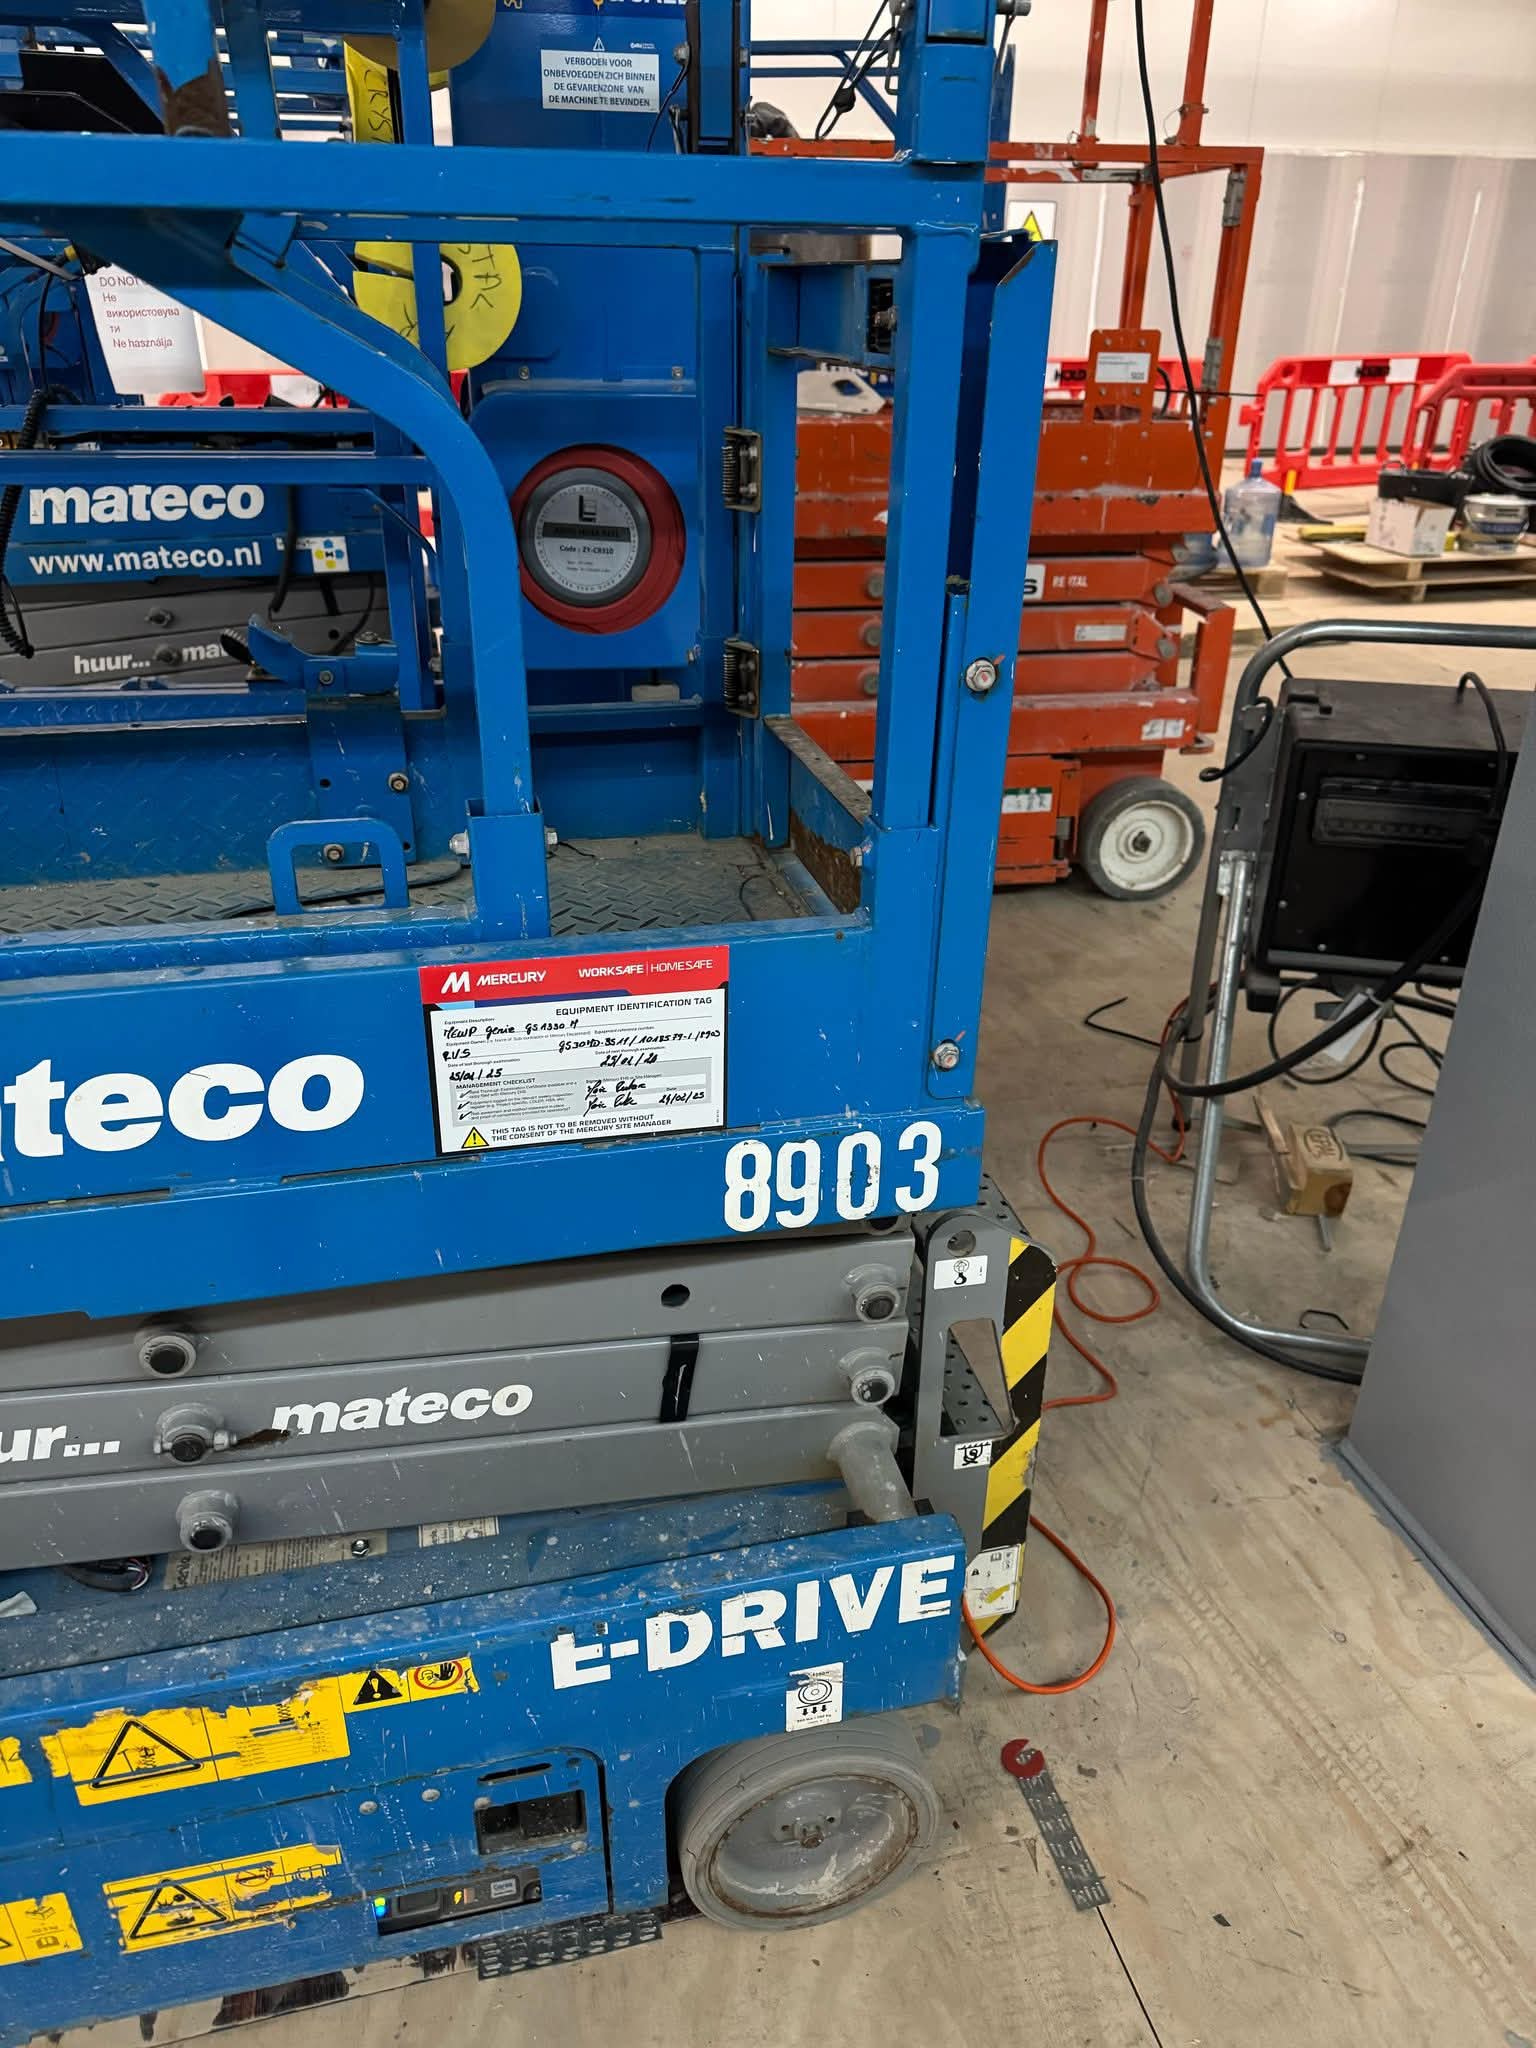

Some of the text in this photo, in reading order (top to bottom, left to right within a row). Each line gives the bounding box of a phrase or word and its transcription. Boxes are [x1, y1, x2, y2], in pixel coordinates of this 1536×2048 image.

[565, 57, 632, 67] VERBODEN VOOR
[543, 69, 656, 81] ONBEVOEGDEN ZICH BINNEN
[554, 82, 644, 94] DE GEVARENZONE VAN
[549, 95, 650, 106] DE MACHINE TE BEVINDEN
[99, 277, 116, 287] DO
[113, 339, 127, 348] Ne
[29, 484, 264, 524] mateco
[29, 542, 262, 575] www.mateco.nl
[73, 653, 151, 674] huur...
[476, 970, 547, 987] MERCURY
[578, 964, 644, 978] WORKSAFE
[650, 959, 713, 973] HOMESAFE
[555, 997, 712, 1016] EQUIPMENT IDENTIFICATION TAG
[456, 1081, 501, 1089] MANAGEMENT
[503, 1078, 535, 1086] CHECKLIST
[0, 1054, 365, 1163] teco
[579, 1117, 617, 1126] REMOVED
[618, 1114, 654, 1122] WITHOUT
[492, 1134, 507, 1142] THE
[509, 1131, 546, 1140] CONSENT
[576, 1125, 613, 1134] MERCURY
[634, 1119, 671, 1128] MANAGER
[724, 1121, 942, 1233] 8903
[270, 1384, 533, 1435] mateco
[550, 1555, 956, 1690] E-DRIVE
